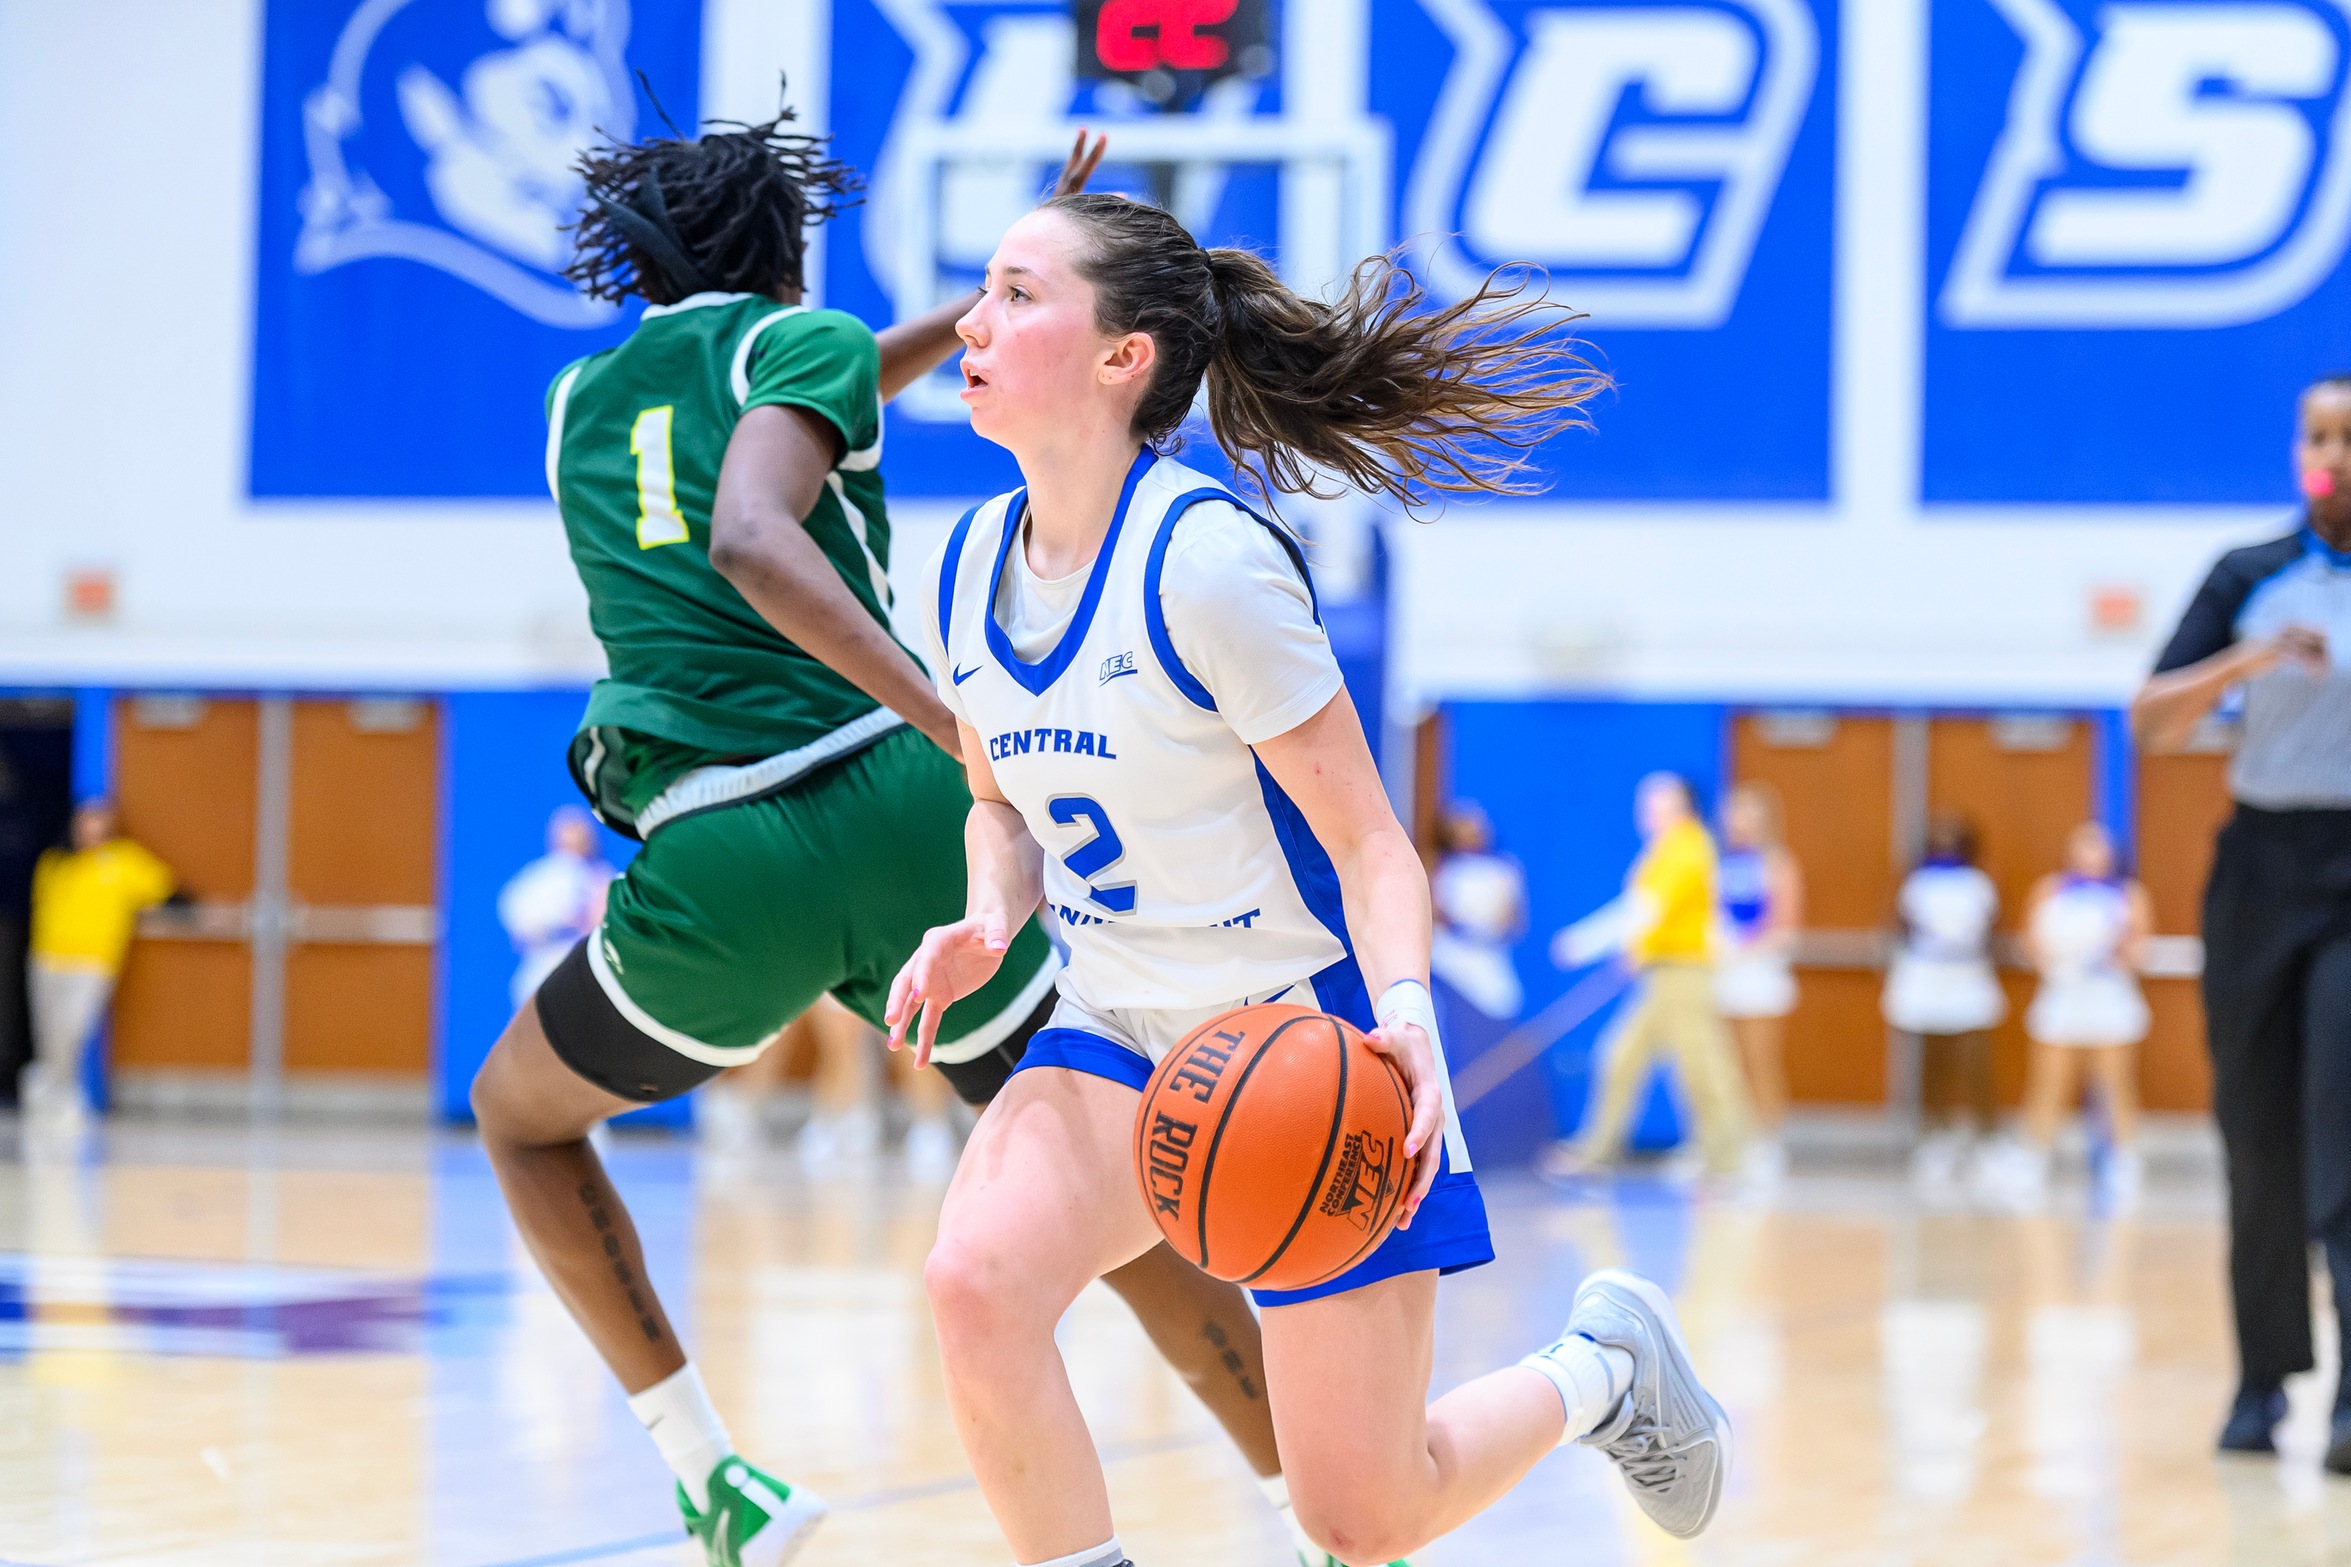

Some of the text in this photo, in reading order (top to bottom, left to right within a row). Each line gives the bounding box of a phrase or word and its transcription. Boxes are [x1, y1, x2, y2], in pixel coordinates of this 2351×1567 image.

[630, 405, 690, 551] 1
[1100, 651, 1134, 680] NEC
[989, 728, 1117, 761] CENTRAL
[1045, 792, 1138, 916] 2
[1149, 1030, 1246, 1222] THE ROCK
[1319, 1132, 1355, 1214] NORTHEAST
[1326, 1134, 1362, 1217] CONFERENCE
[1346, 1129, 1385, 1231] NEC
